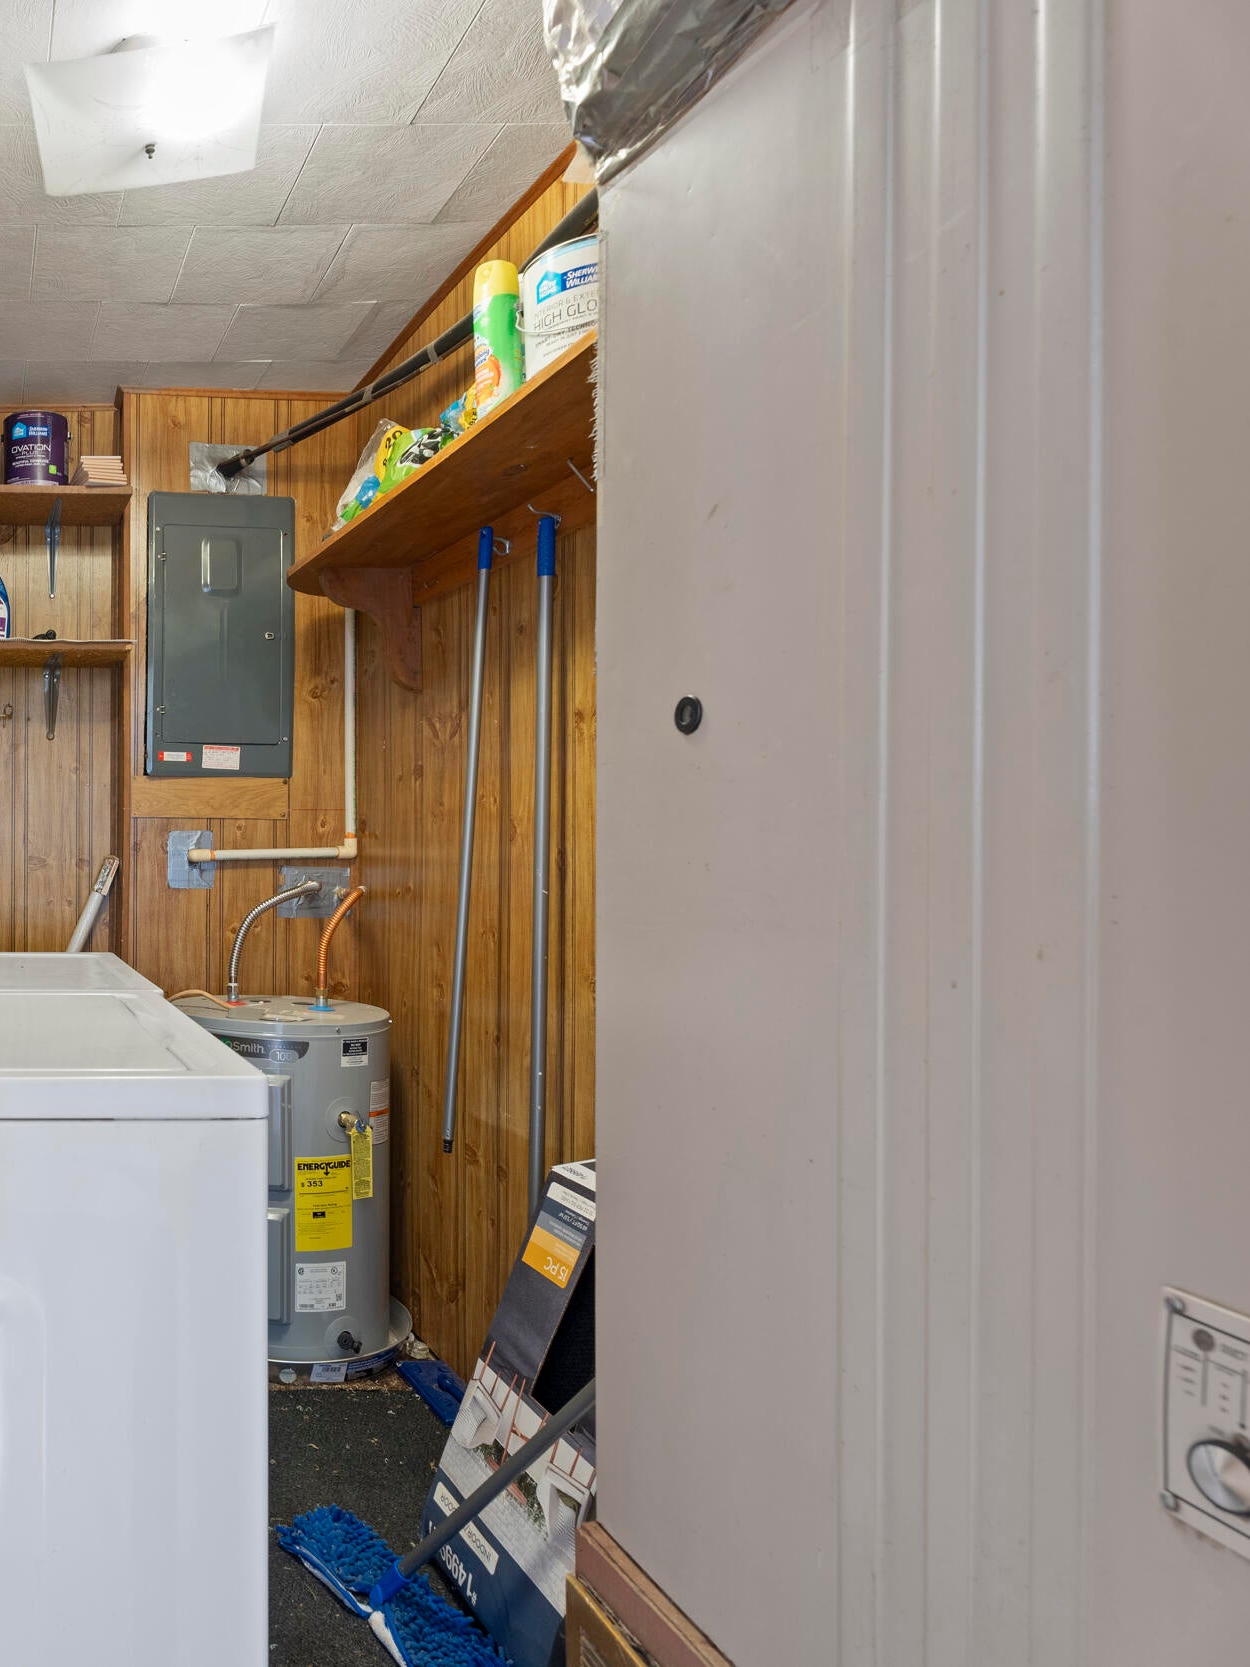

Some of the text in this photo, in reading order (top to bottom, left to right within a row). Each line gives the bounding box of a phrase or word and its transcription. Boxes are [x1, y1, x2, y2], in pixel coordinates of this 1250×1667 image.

[566, 266, 598, 280] SHERWI
[565, 274, 598, 289] WILLIA
[533, 309, 562, 331] HIGH
[566, 299, 598, 317] GLO
[11, 443, 51, 454] OVATION
[233, 1041, 264, 1054] Smith
[297, 1160, 350, 1175] ENERGYGUIDE
[306, 1180, 323, 1188] 353
[543, 1256, 569, 1282] 15 PC
